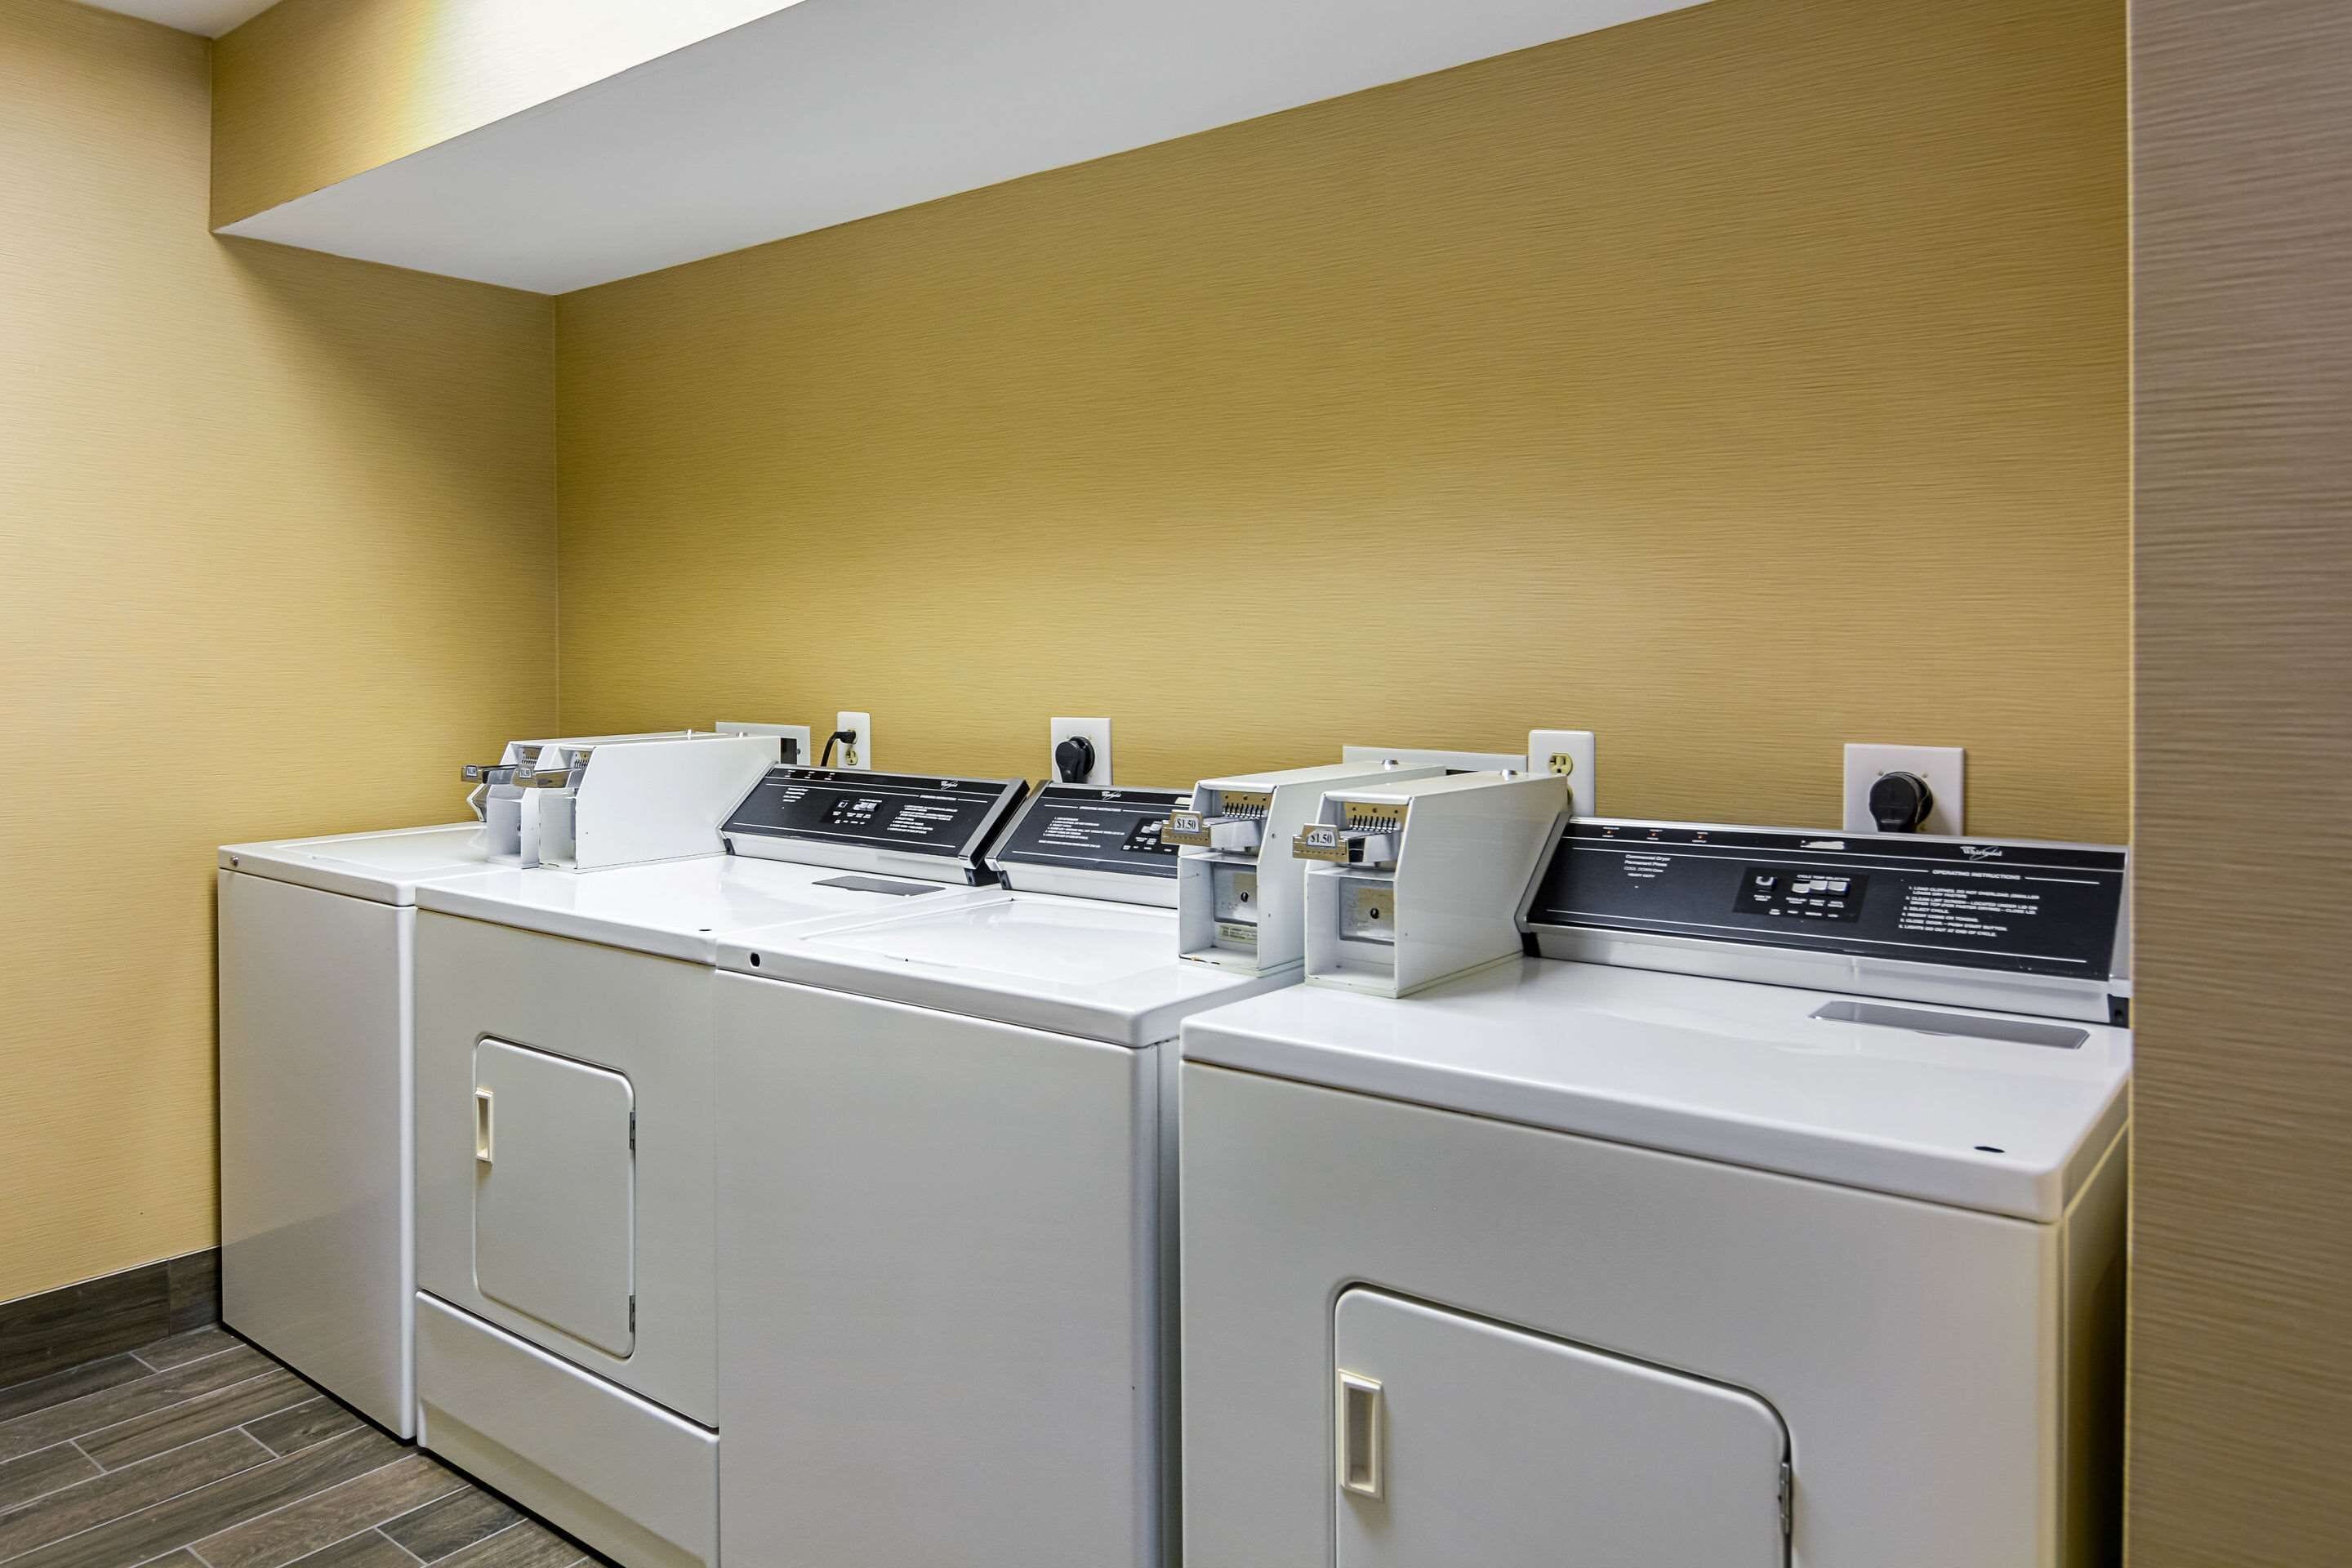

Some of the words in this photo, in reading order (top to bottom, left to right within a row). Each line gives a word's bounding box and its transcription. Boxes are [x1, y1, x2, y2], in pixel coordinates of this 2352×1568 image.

[1176, 818, 1196, 829] $1.50
[1309, 834, 1332, 844] $1.50
[1960, 846, 2002, 858] Whirlpool
